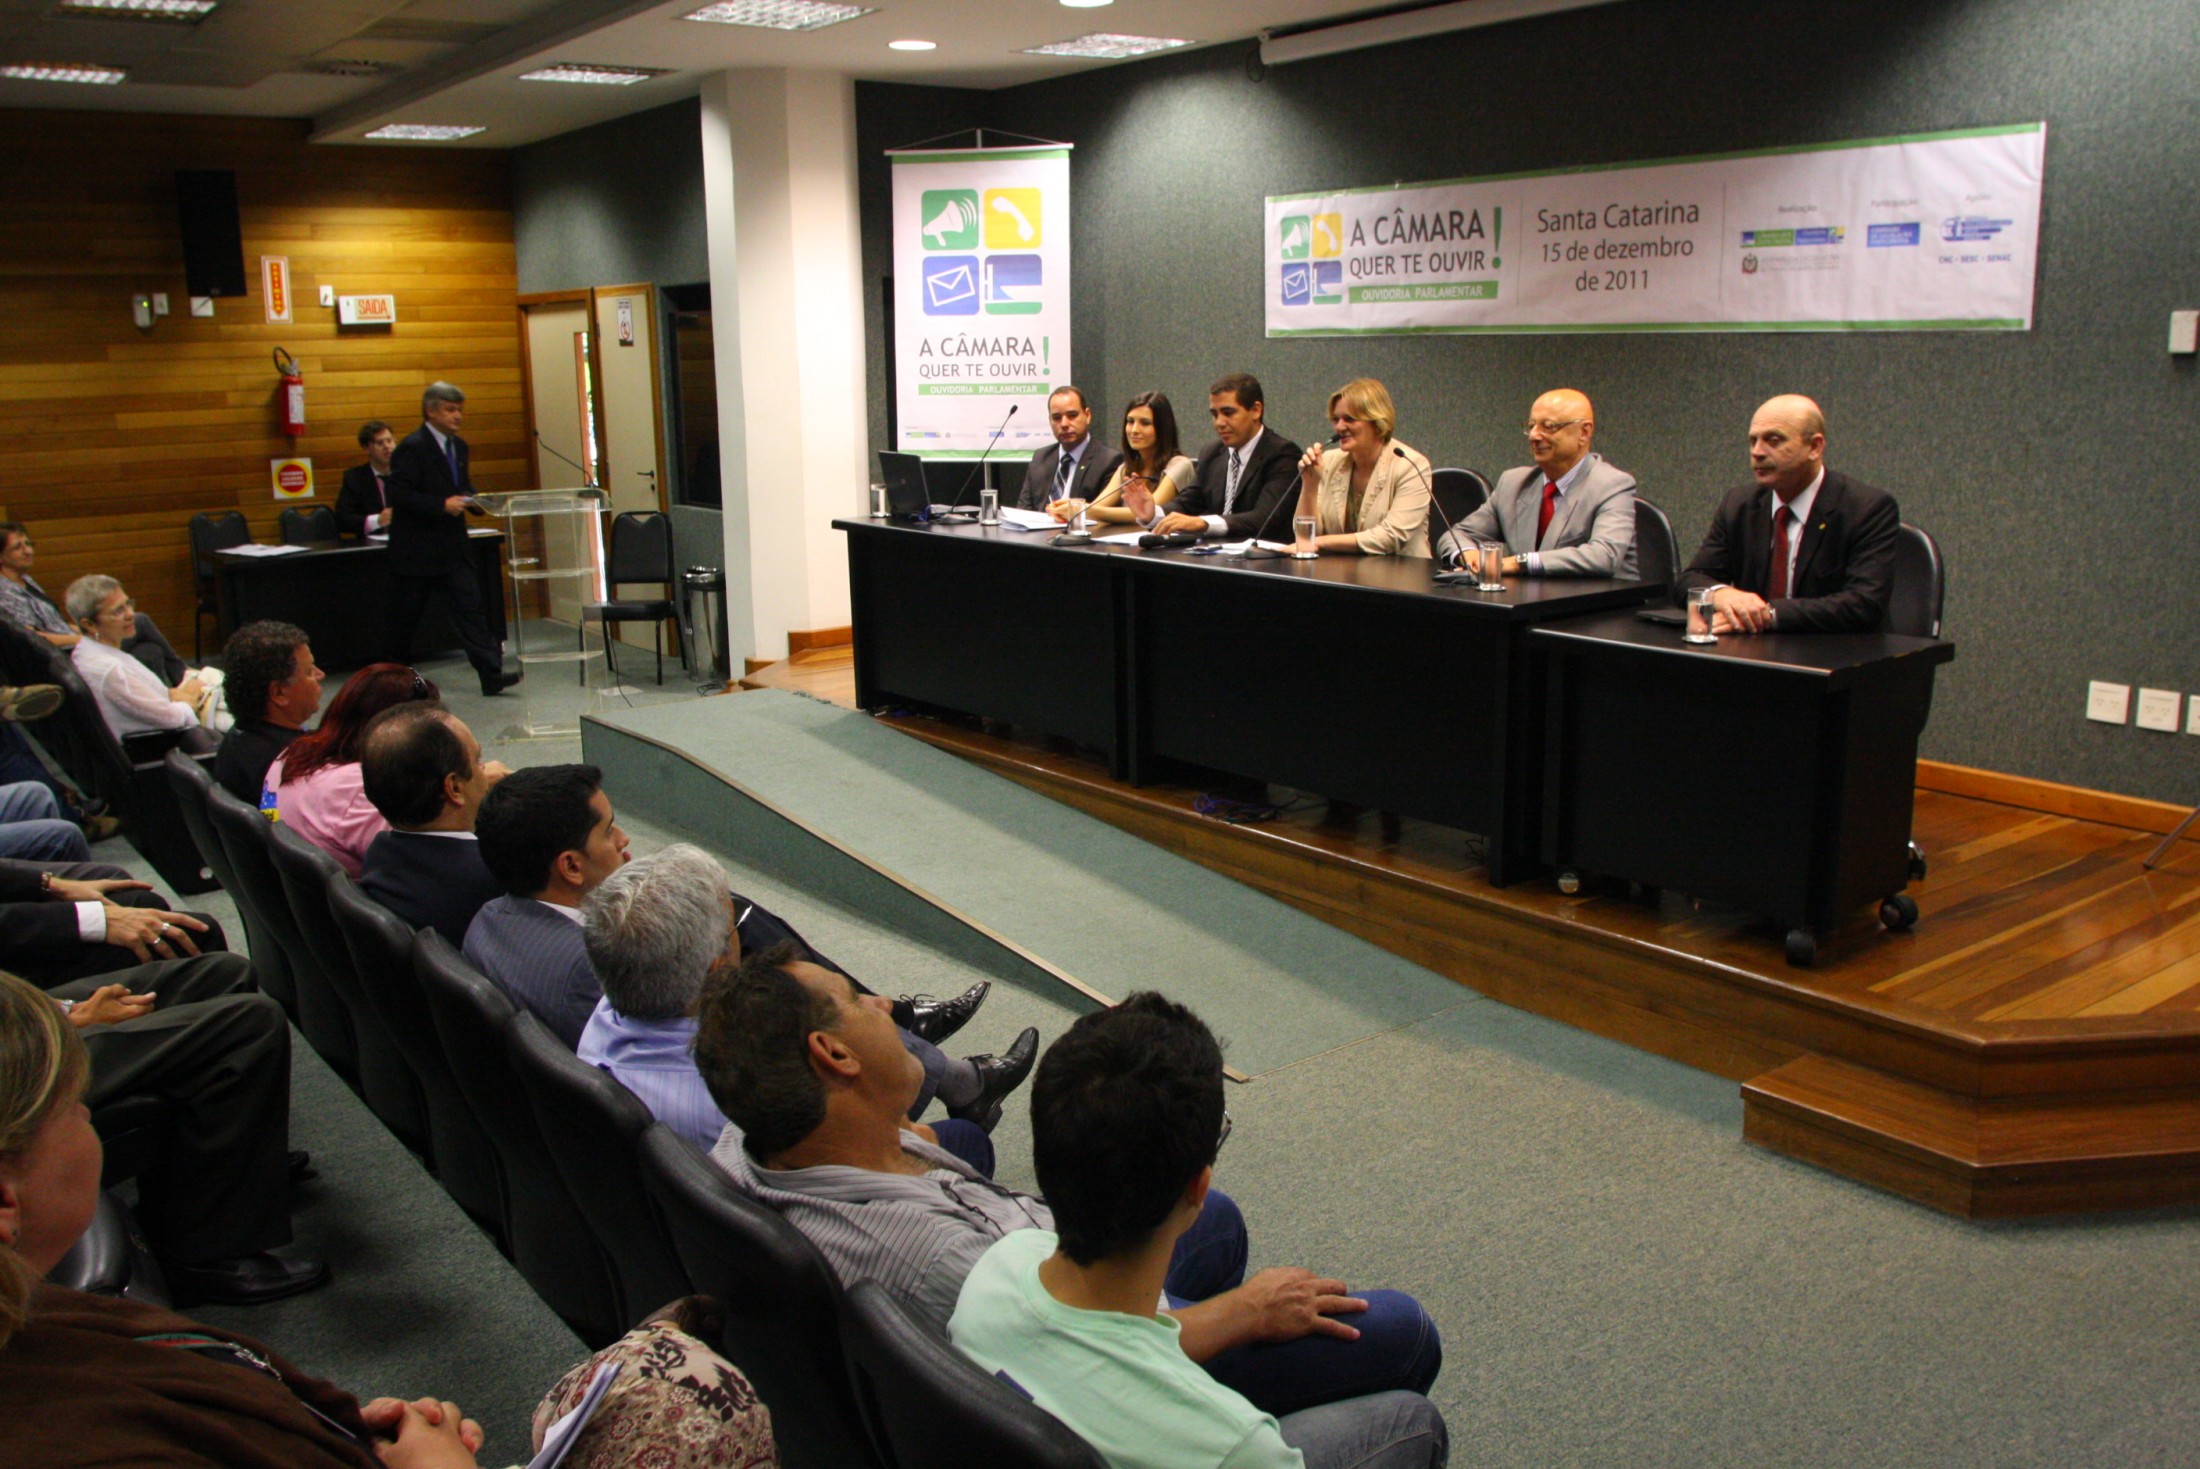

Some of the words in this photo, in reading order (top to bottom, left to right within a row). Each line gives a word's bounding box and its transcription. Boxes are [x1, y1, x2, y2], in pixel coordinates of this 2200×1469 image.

[1350, 218, 1366, 247] A
[1373, 207, 1485, 246] CÂMARA
[1537, 208, 1597, 233] Santa
[1603, 200, 1699, 229] Catarina
[1541, 242, 1561, 263] 15
[1566, 240, 1589, 262] de
[1593, 235, 1694, 260] dezembro
[1350, 254, 1396, 280] QUER
[1401, 253, 1423, 274] TE
[1429, 250, 1485, 273] OUVIR
[1361, 287, 1411, 301] OUVIDORIA
[1415, 285, 1484, 299] PARLAMENTAR
[1575, 269, 1599, 292] de
[1604, 269, 1649, 291] 2011
[919, 337, 934, 357] A
[940, 332, 1036, 357] CÂMARA
[919, 363, 961, 380] QUER
[965, 363, 984, 377] TE
[989, 362, 1038, 377] OUVIR
[930, 385, 974, 394] OUVIDORIA
[978, 384, 1038, 394] PARLAMENTAR
